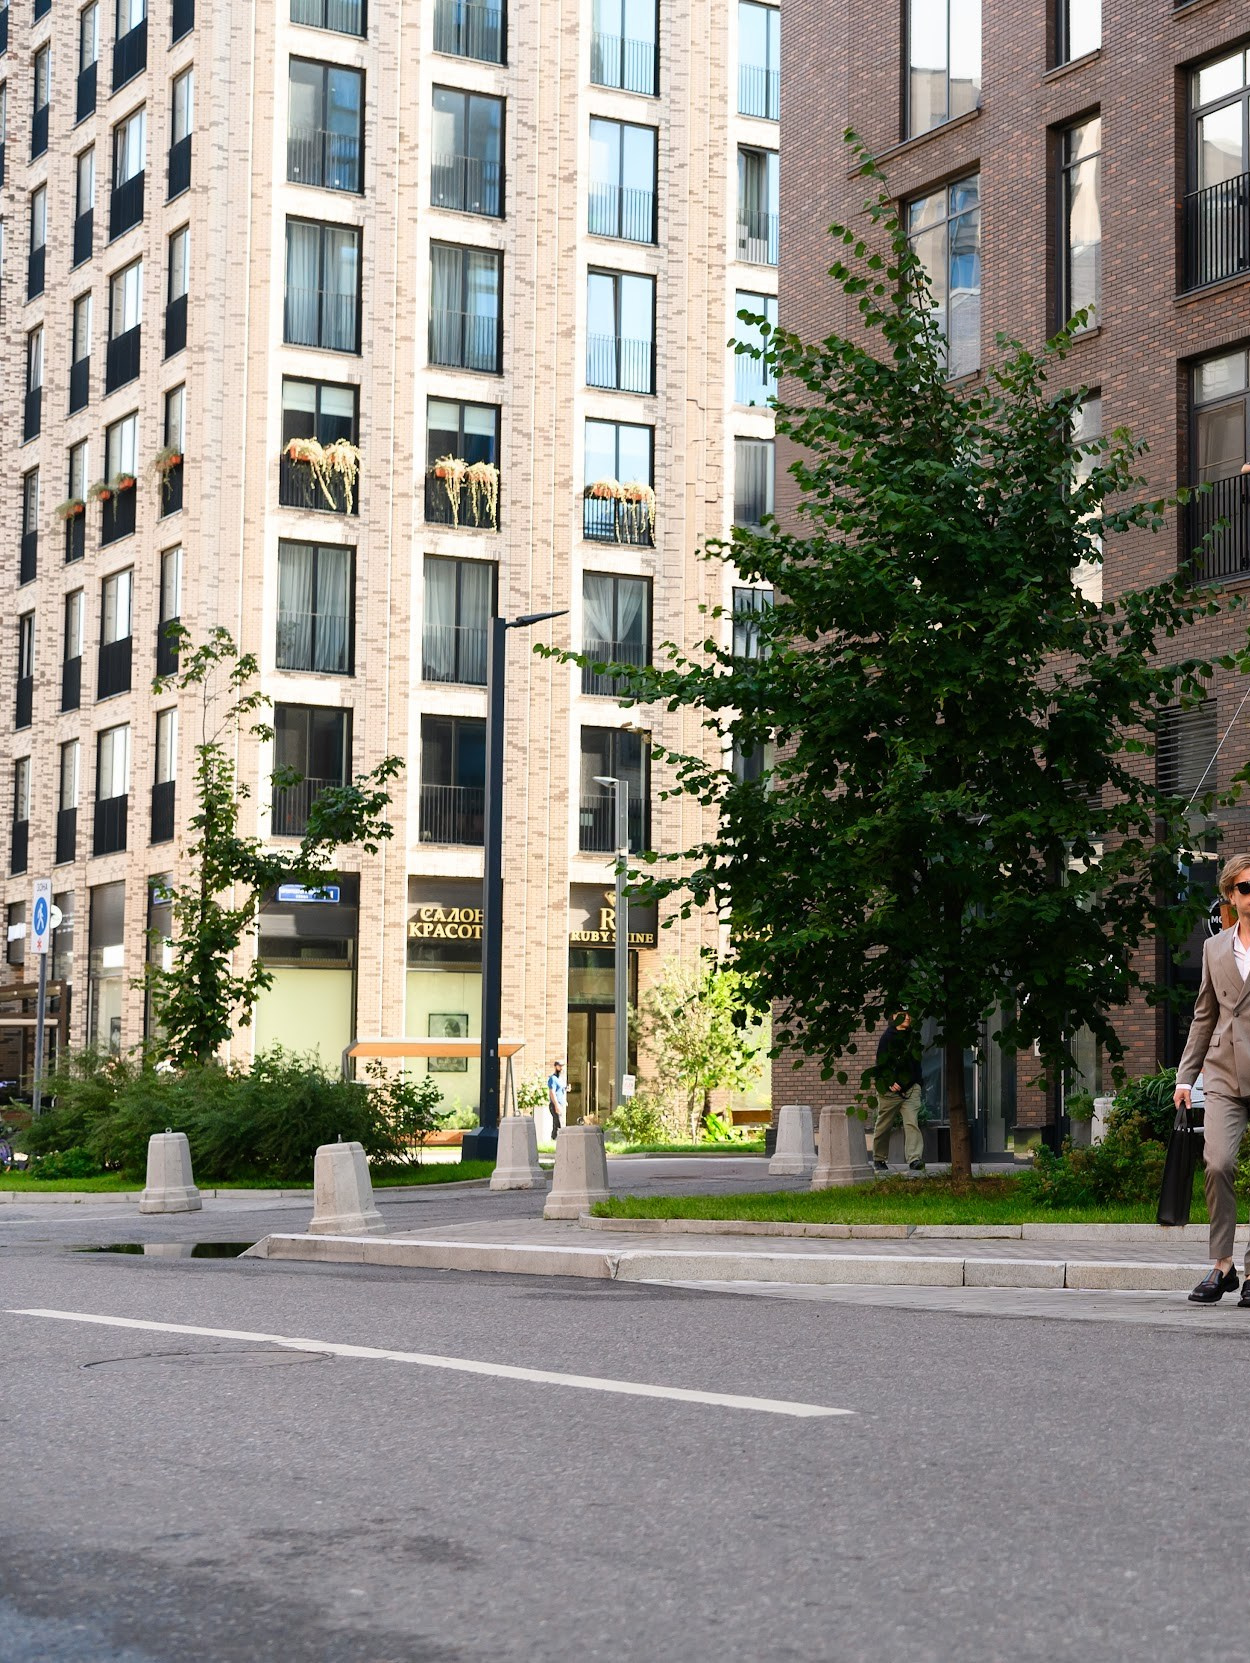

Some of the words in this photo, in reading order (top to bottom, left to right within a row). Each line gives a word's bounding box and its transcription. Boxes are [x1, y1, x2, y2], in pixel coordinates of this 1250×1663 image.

[420, 907, 484, 923] САЛОН
[409, 922, 484, 939] КРАСОТ
[570, 930, 610, 942] RUBY
[612, 932, 653, 943] SINE
